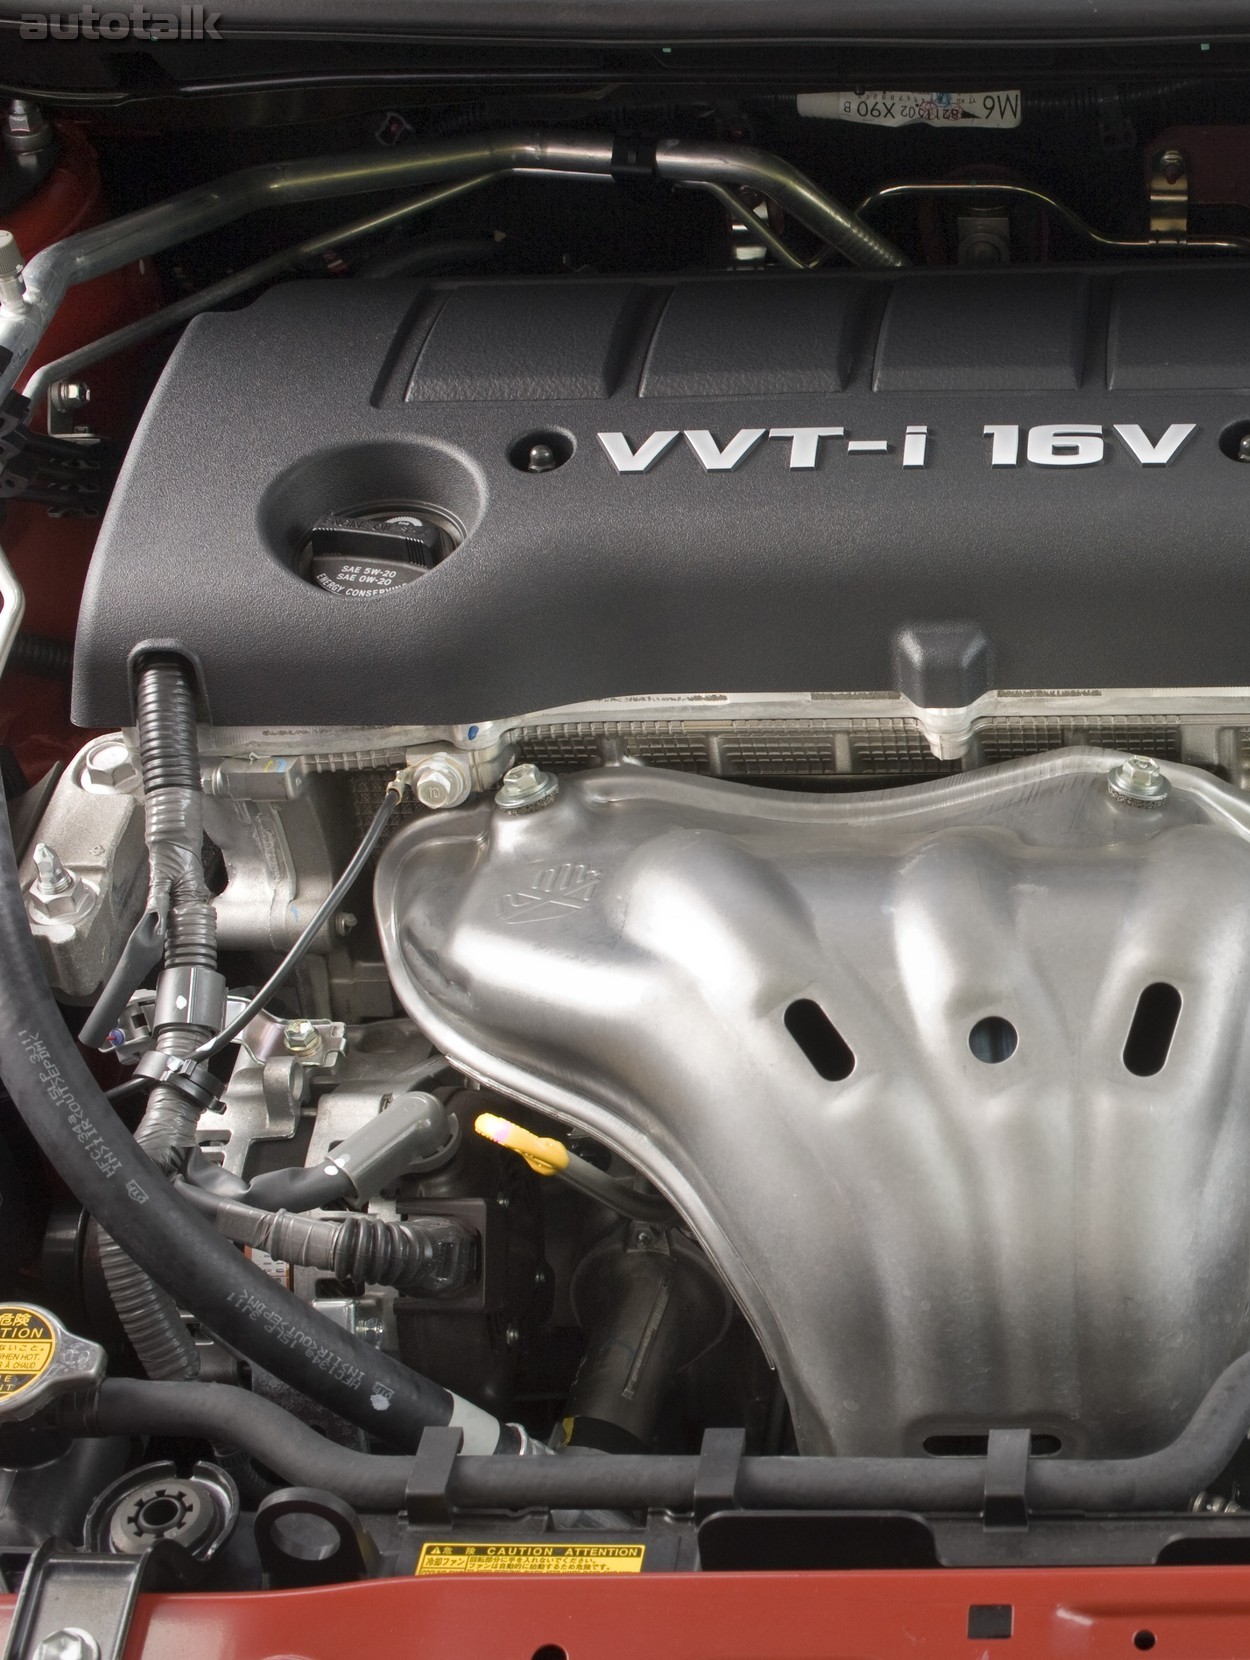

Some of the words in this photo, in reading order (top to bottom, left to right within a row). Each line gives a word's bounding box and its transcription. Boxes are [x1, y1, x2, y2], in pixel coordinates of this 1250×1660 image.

[982, 94, 1019, 120] M6
[597, 425, 929, 474] VVT-i
[983, 422, 1197, 470] 16V
[341, 565, 360, 574] SAE
[363, 566, 397, 578] 5W-20
[316, 572, 345, 596] ENERGY
[336, 573, 356, 582] SAE
[358, 575, 392, 586] 0W-20
[0, 1313, 32, 1326] 危険
[0, 1328, 43, 1338] TION
[0, 1353, 19, 1361] HEN
[13, 1361, 36, 1369] CHAUD
[487, 1546, 553, 1556] CAUTION
[564, 1547, 638, 1557] ATTENTION
